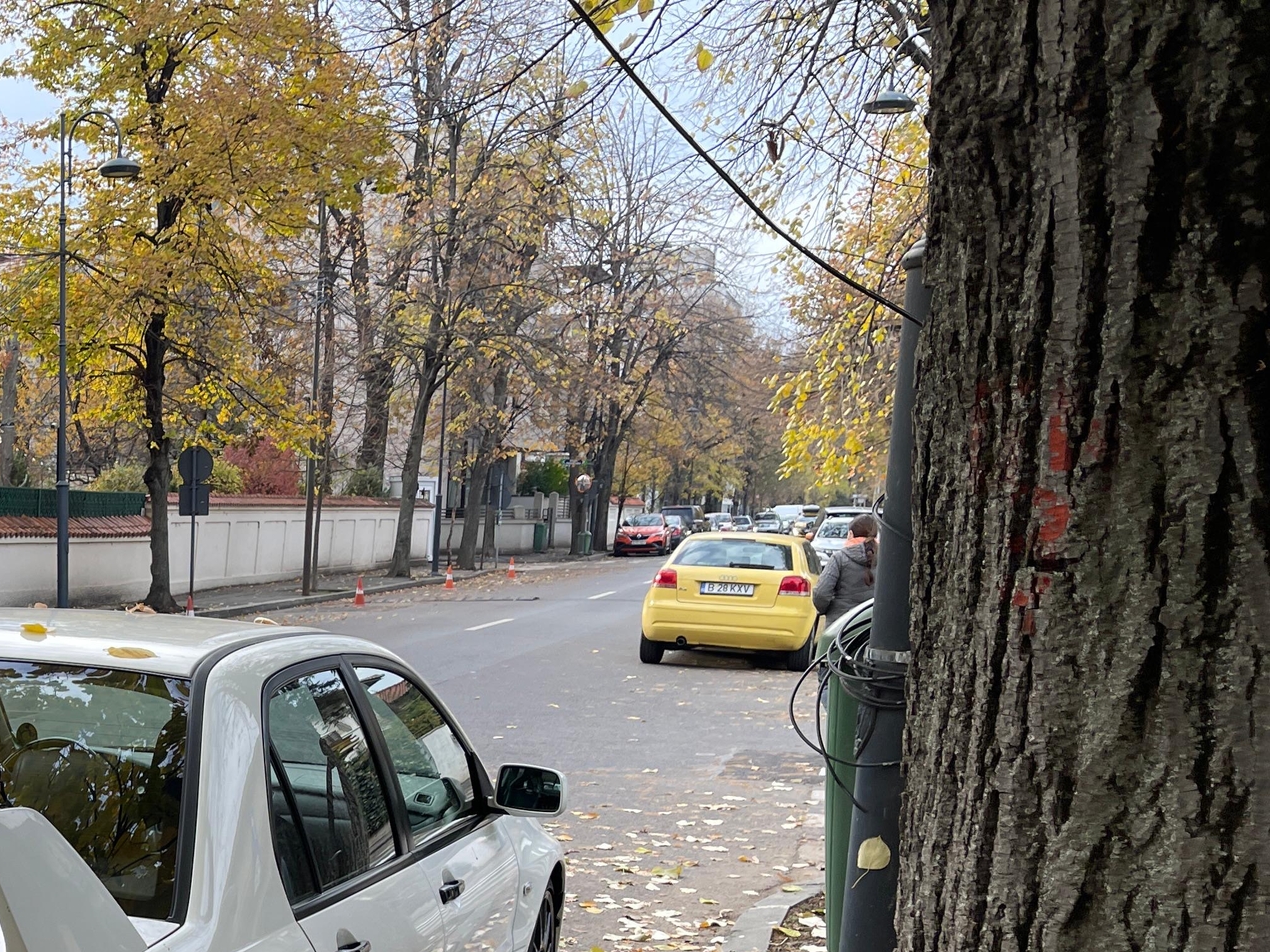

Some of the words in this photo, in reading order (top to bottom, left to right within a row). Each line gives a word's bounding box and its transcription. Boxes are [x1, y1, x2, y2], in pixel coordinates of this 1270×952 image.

[707, 583, 715, 592] B
[717, 583, 728, 592] 28
[729, 584, 750, 593] KXV
